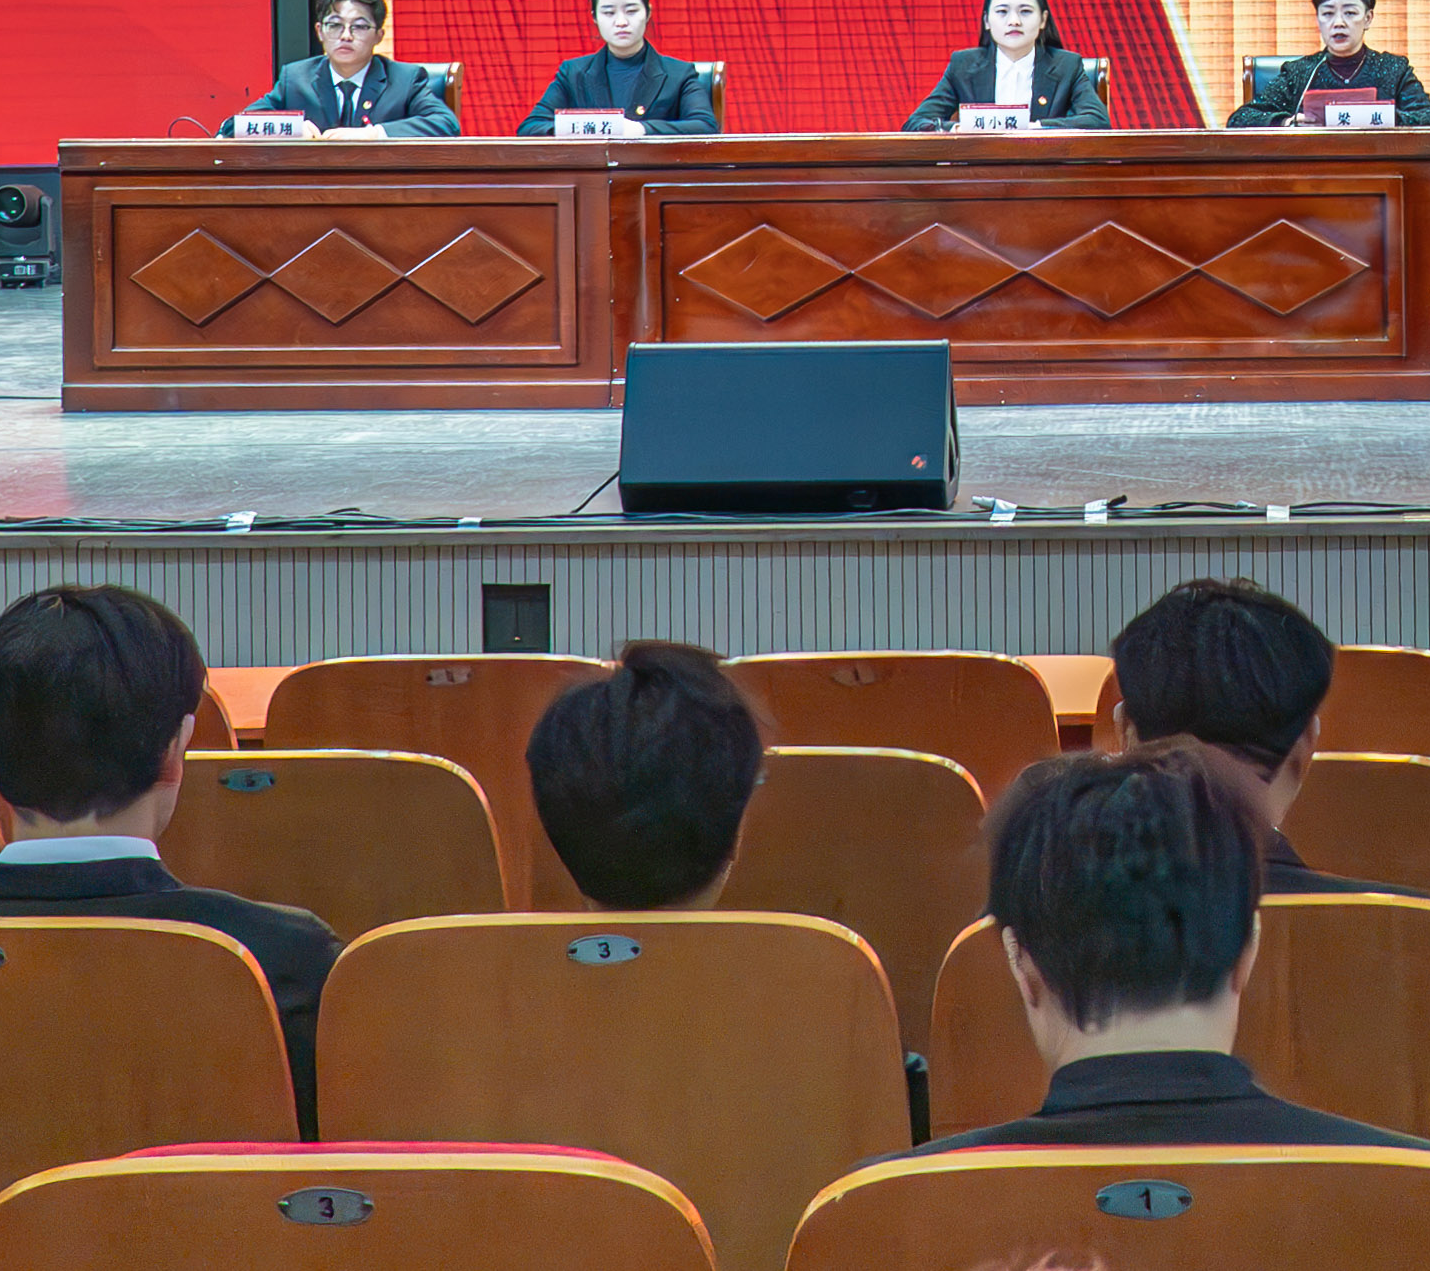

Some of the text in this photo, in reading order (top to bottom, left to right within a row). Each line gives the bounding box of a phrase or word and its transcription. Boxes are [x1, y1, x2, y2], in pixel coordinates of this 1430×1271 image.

[598, 941, 611, 959] 3
[318, 1196, 335, 1218] 3
[1137, 1186, 1152, 1213] 1
